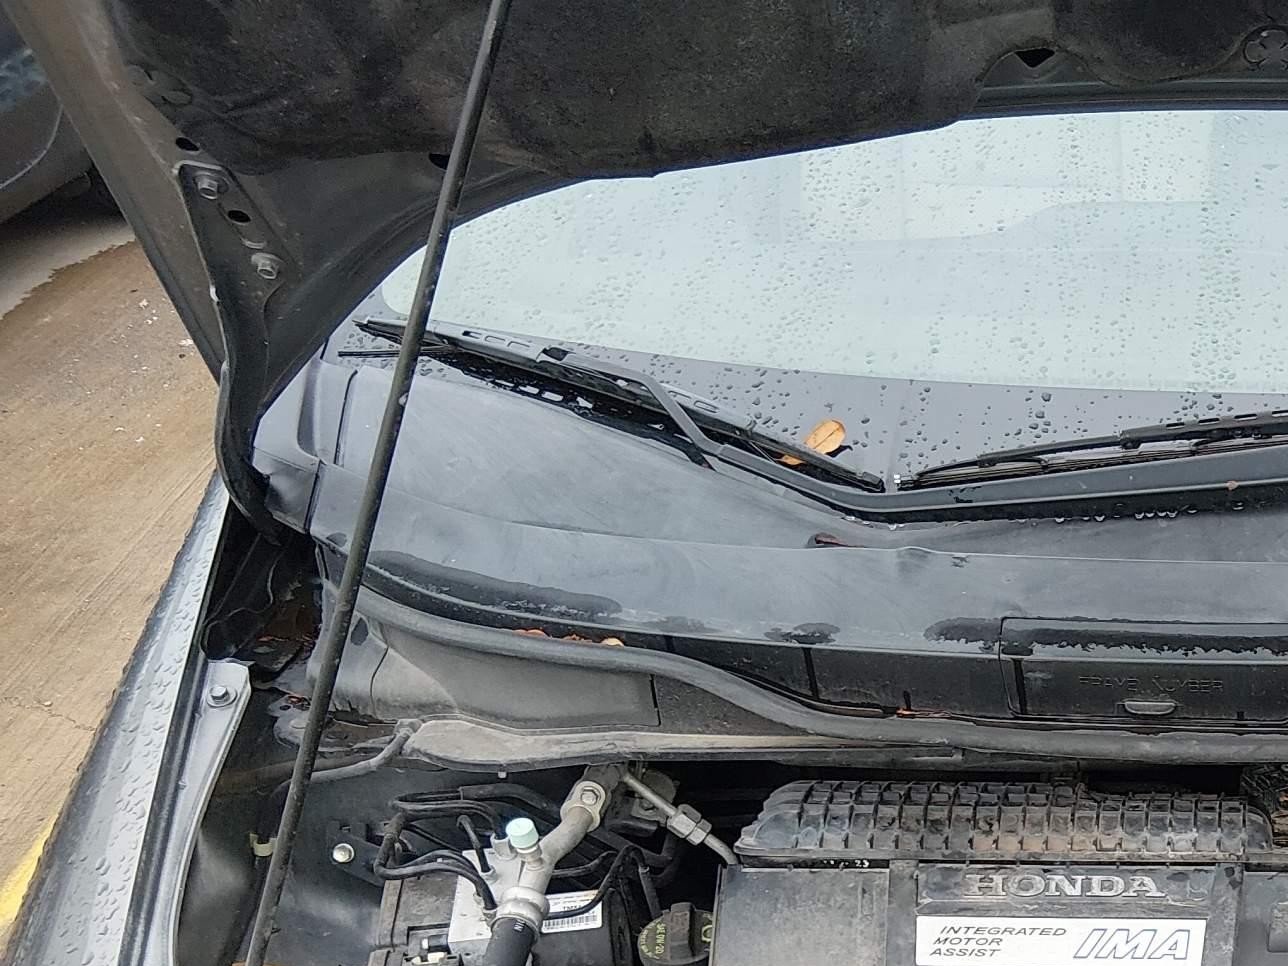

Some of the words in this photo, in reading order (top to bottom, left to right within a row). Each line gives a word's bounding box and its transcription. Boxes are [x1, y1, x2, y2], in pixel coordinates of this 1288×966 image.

[964, 874, 1167, 899] HONDA
[940, 926, 1067, 937] INTEGRATED
[933, 937, 1003, 946] MOTOR
[1073, 928, 1191, 960] IMA
[929, 948, 1001, 958] ASSIST
